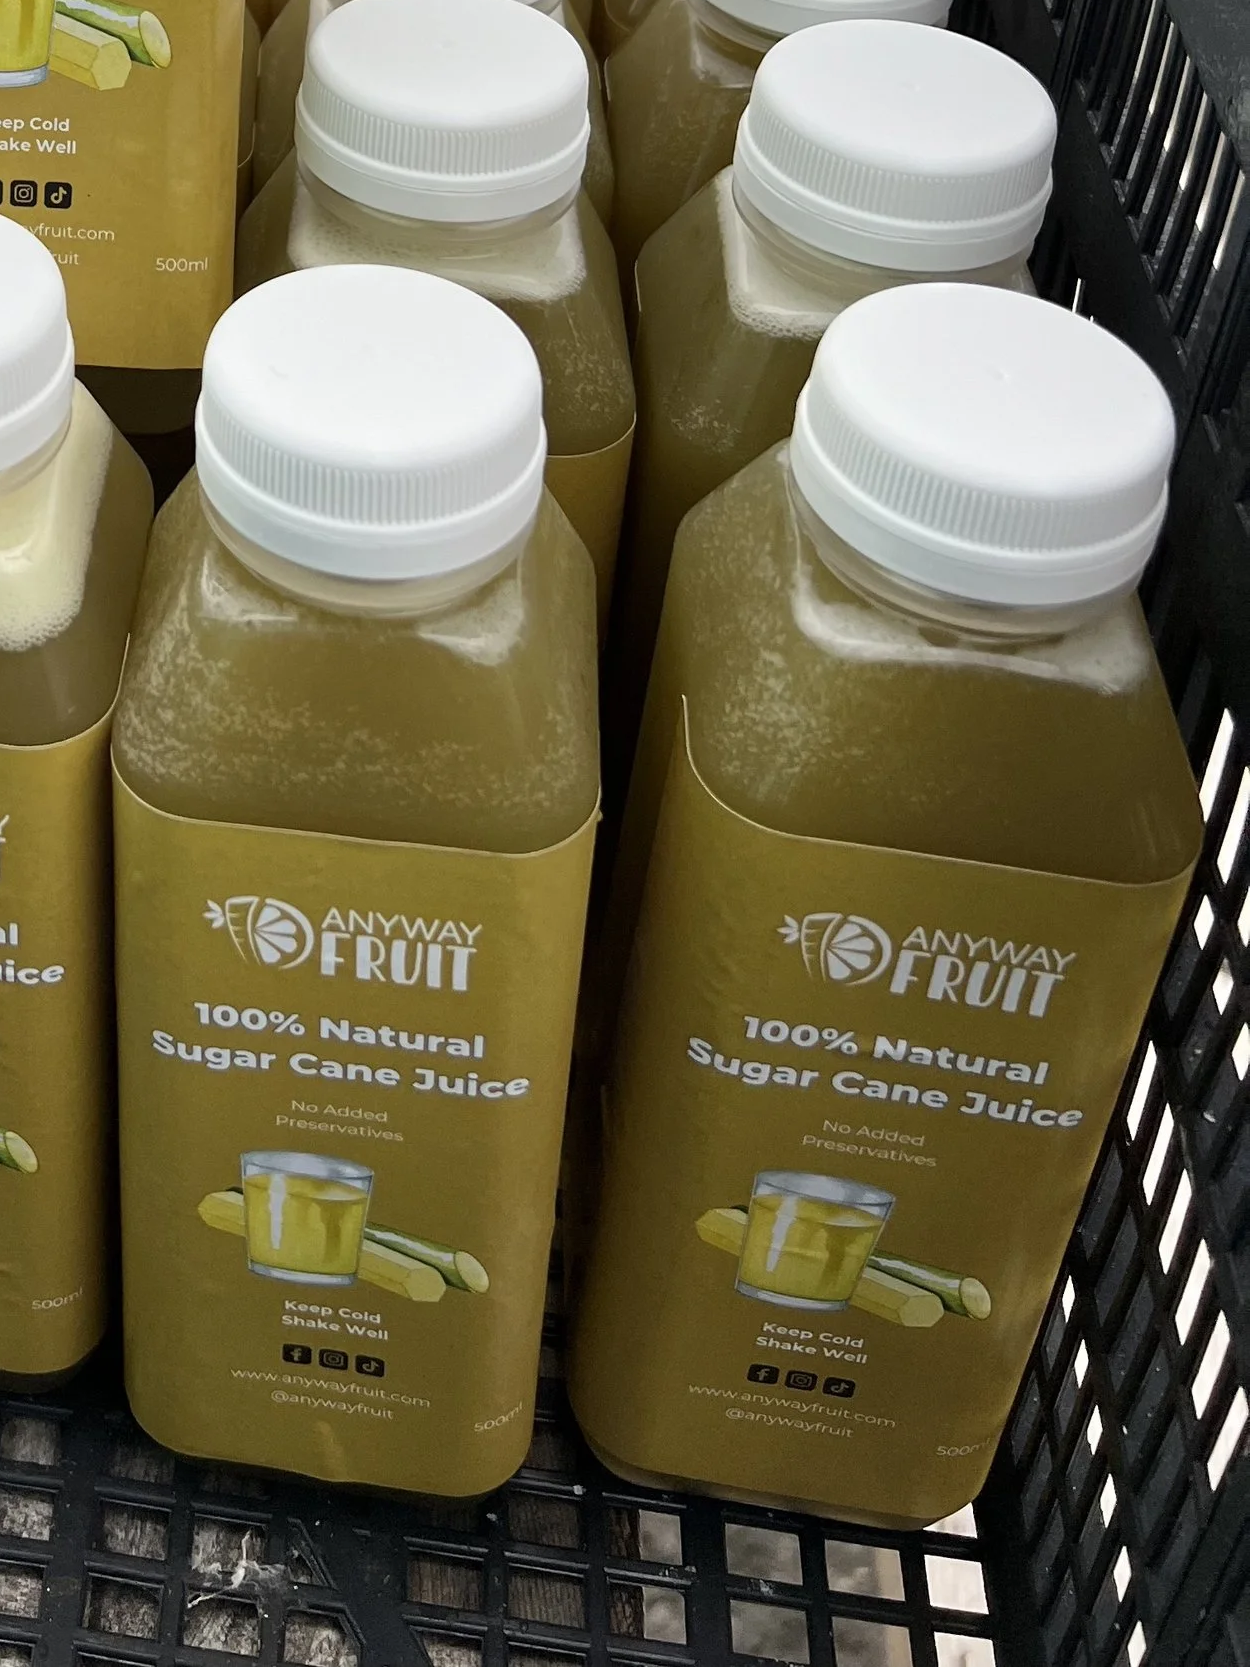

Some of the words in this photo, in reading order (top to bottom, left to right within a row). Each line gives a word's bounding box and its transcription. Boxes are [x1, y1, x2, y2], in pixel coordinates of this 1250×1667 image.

[30, 117, 69, 132] Cold
[36, 139, 76, 154] Well
[156, 258, 208, 272] 500ml
[322, 907, 482, 946] ANYWAY
[321, 930, 477, 992] FRUIT
[903, 925, 1077, 973] ANYWAY
[890, 949, 1065, 1018] FRUIT
[194, 1001, 306, 1036] 100%
[319, 1016, 485, 1059] Natural
[152, 1029, 276, 1070] Sugar
[289, 1053, 400, 1086] Cane
[412, 1068, 530, 1099] Juice
[744, 1015, 859, 1056] 100%
[873, 1035, 1049, 1085] Natural
[687, 1037, 819, 1086] Sugar
[831, 1071, 949, 1109] Cane
[960, 1091, 1083, 1128] Juice
[291, 1100, 318, 1113] No
[323, 1103, 388, 1123] Added
[276, 1114, 404, 1142] Preservatives
[823, 1119, 851, 1134] No
[856, 1124, 925, 1146] Added
[803, 1134, 937, 1167] Preservatives
[282, 1314, 340, 1332] Shake
[345, 1322, 389, 1340] Well
[285, 1300, 332, 1317] Keep
[338, 1307, 381, 1324] Cold
[756, 1336, 816, 1355] Shake
[823, 1346, 868, 1364] Well
[762, 1322, 814, 1340] Keep
[819, 1332, 864, 1348] Cold
[231, 1367, 431, 1408] www.anywayfruit.com
[271, 1390, 394, 1420] @anywayfruit
[689, 1384, 897, 1428] www.anywayfruit.com
[726, 1408, 854, 1438] @anywayfruit
